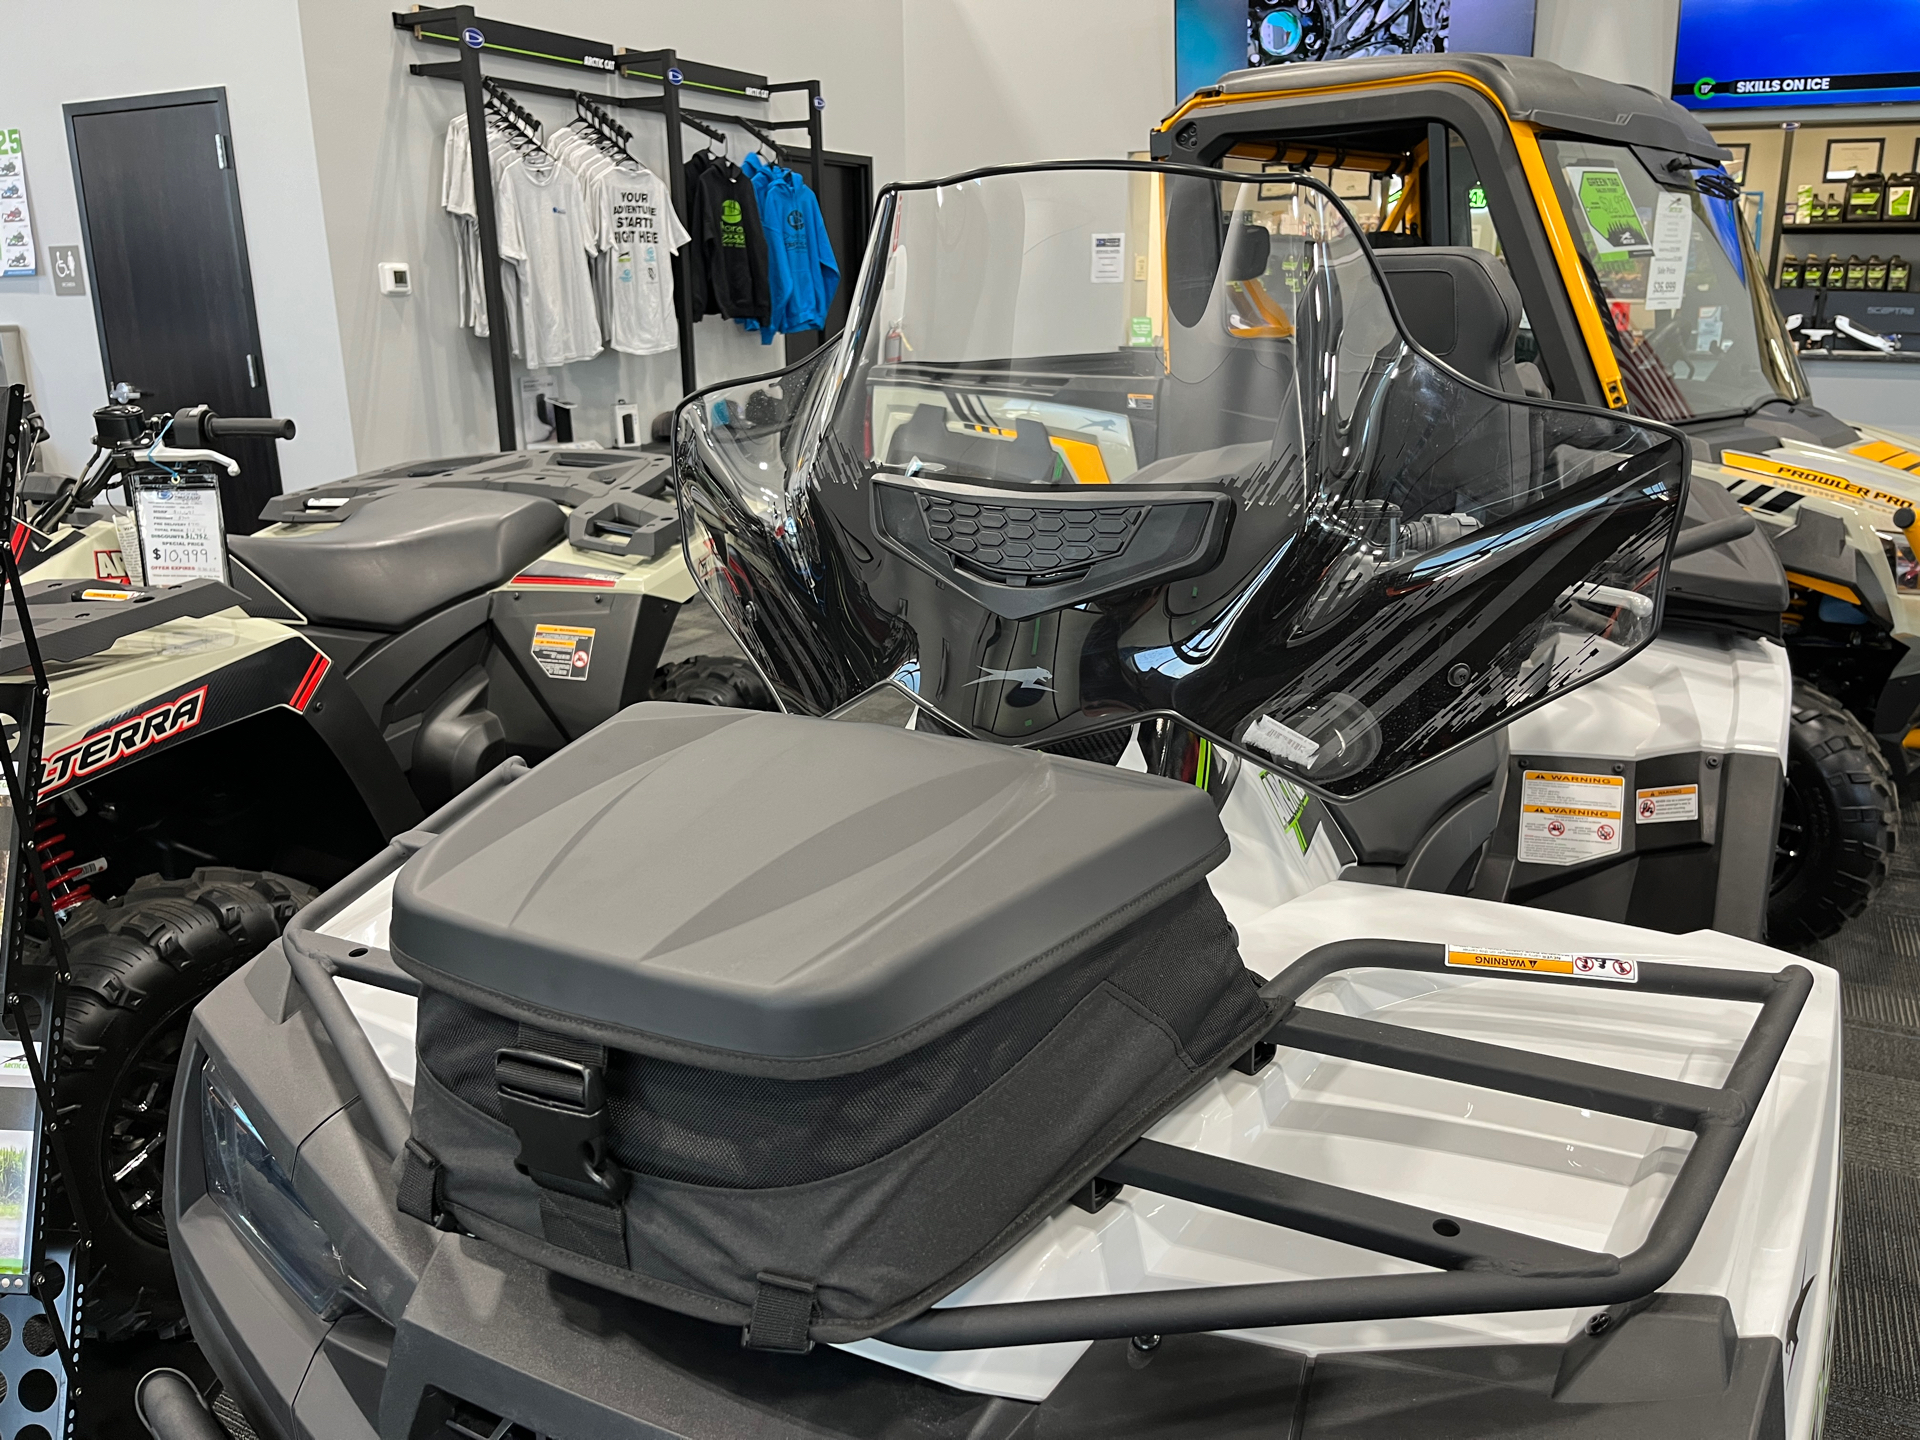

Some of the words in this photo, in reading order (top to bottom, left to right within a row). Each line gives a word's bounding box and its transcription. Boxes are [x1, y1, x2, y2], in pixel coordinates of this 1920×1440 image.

[584, 56, 604, 69] ARCTIC
[604, 60, 615, 70] CAT
[1736, 79, 1781, 93] SKILLS
[1782, 79, 1804, 91] ON
[1806, 78, 1830, 90] ICE
[745, 87, 759, 97] ARCTIC
[759, 89, 770, 98] CAT
[621, 192, 648, 203] YOUR
[613, 205, 657, 216] ADVENTURE
[616, 216, 653, 228] STARTS
[614, 230, 636, 244] RIGHT
[639, 231, 659, 244] HERE
[1777, 467, 1870, 498] PROWLER
[1873, 491, 1914, 509] PRO
[152, 547, 209, 563] $10,999
[38, 690, 204, 790] LTERRA
[1551, 774, 1611, 785] WARNING
[1658, 788, 1682, 796] WARNING
[1548, 807, 1609, 817] WARNING
[1475, 955, 1527, 968] WARNING
